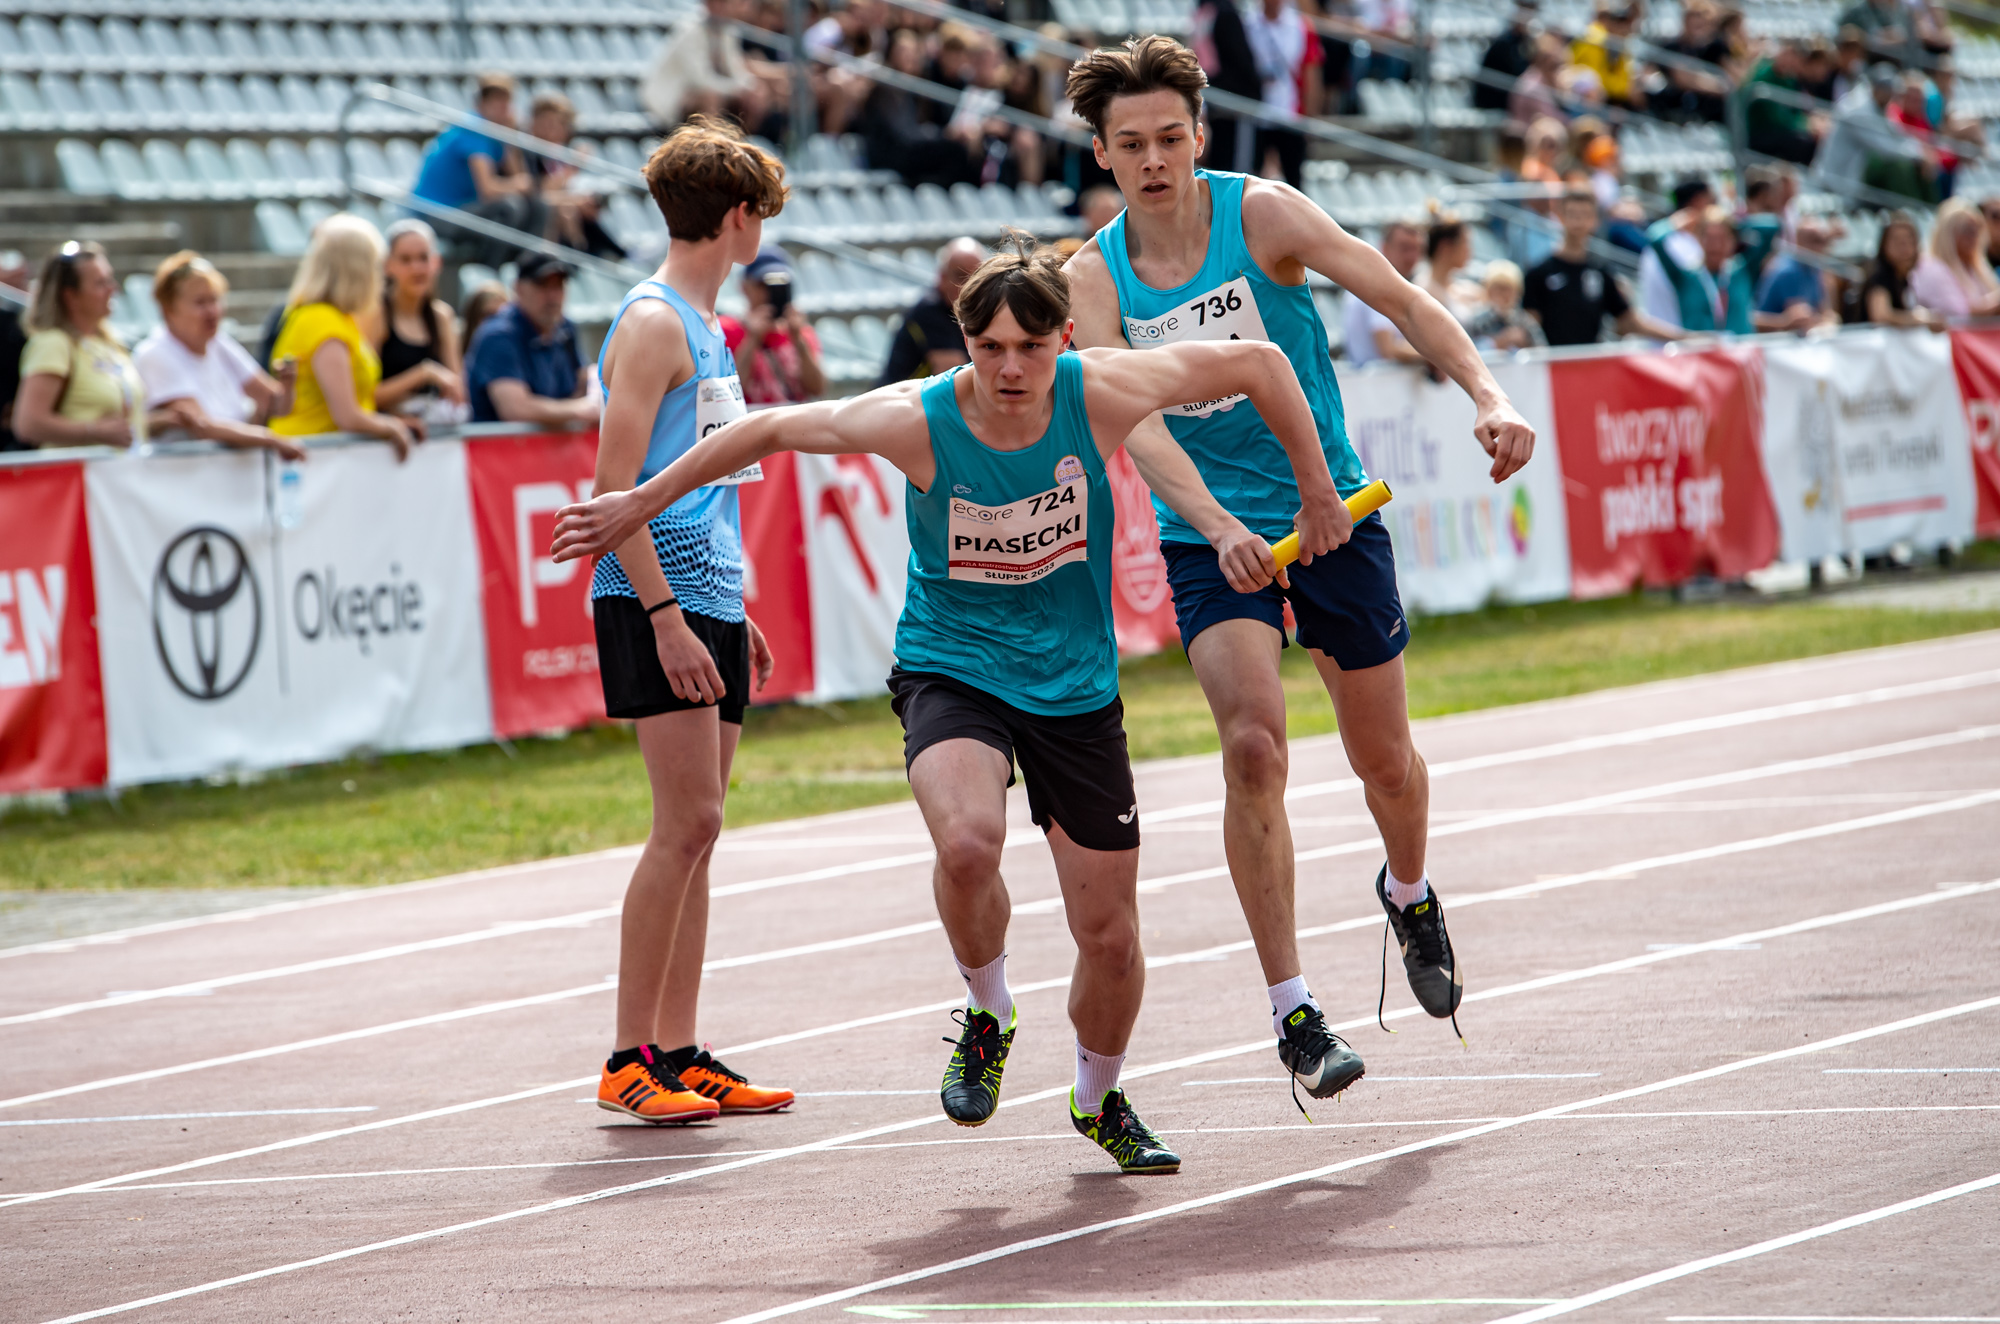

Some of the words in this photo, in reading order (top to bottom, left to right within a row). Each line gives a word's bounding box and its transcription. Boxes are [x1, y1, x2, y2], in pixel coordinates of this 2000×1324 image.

[1190, 287, 1243, 327] 736
[1129, 317, 1179, 339] ecore
[953, 502, 1014, 521] ecore
[1028, 485, 1077, 517] 724
[954, 514, 1081, 554] PIASECKI
[978, 562, 1019, 570] Mistrzostwa
[1020, 561, 1039, 571] Polski
[984, 571, 1029, 581] SŁUPSK
[1030, 561, 1055, 579] 2023
[292, 562, 424, 658] Okęcie
